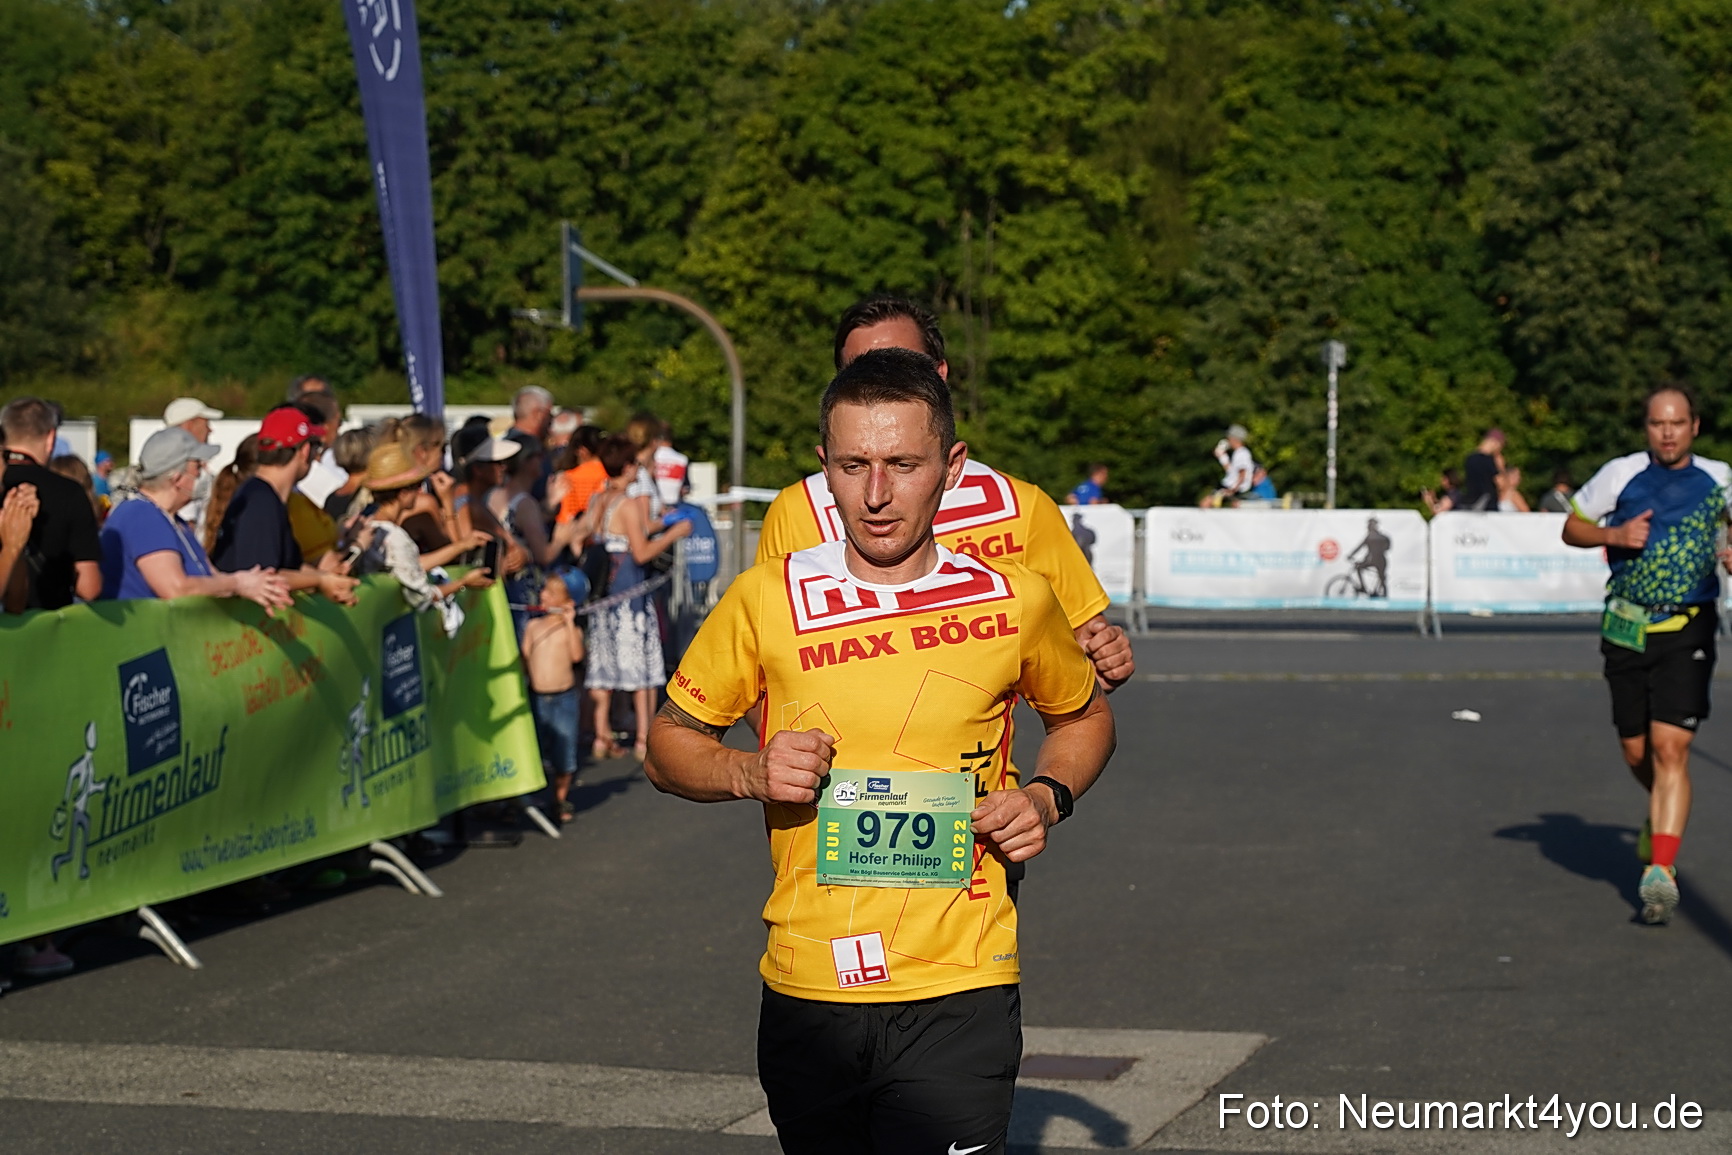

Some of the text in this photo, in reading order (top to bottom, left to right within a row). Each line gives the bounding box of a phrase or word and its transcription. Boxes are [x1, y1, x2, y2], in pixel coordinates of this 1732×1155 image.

[799, 612, 1019, 672] MAX BÖGL
[132, 686, 171, 716] Fischer
[101, 724, 229, 840] firmenlauf
[859, 792, 908, 801] Firmenlauf
[826, 821, 841, 861] RUN
[857, 811, 936, 850] 979
[952, 819, 967, 872] 2022
[849, 851, 941, 869] Hofer Philipp
